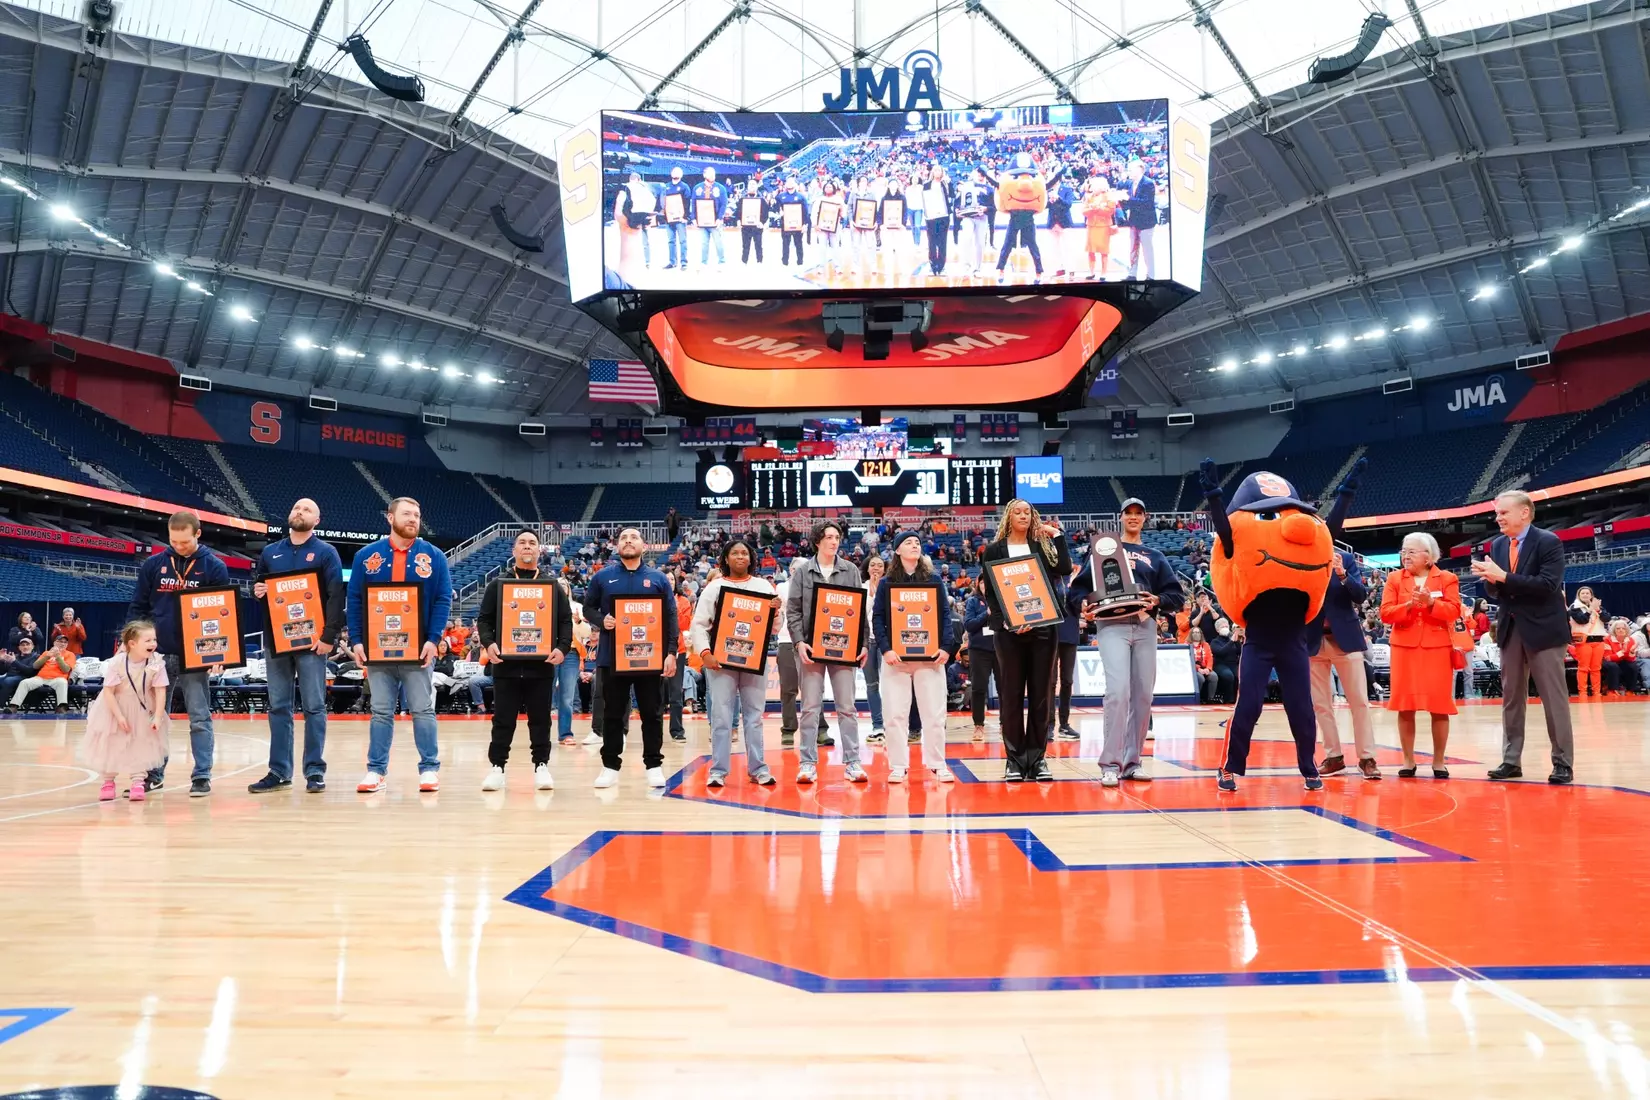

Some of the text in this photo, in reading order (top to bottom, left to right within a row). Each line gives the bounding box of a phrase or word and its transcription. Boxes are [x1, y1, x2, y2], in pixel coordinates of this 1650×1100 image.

[822, 67, 943, 110] JMA
[561, 128, 599, 224] S
[713, 334, 823, 362] JMA
[915, 329, 1030, 361] JMA
[1447, 382, 1507, 412] JMA
[250, 401, 282, 445] S
[734, 423, 754, 436] 44
[321, 424, 406, 449] SYRACUSE
[862, 461, 891, 477] 12:14
[819, 473, 836, 495] 41
[916, 472, 936, 494] 30
[1255, 473, 1291, 497] S
[716, 496, 740, 504] WEBB
[16, 528, 51, 540] SIMMONS
[69, 534, 85, 544] DICK
[268, 526, 283, 534] DAY.
[326, 530, 341, 538] GIVE
[347, 531, 368, 539] ROUND
[414, 552, 433, 578] S
